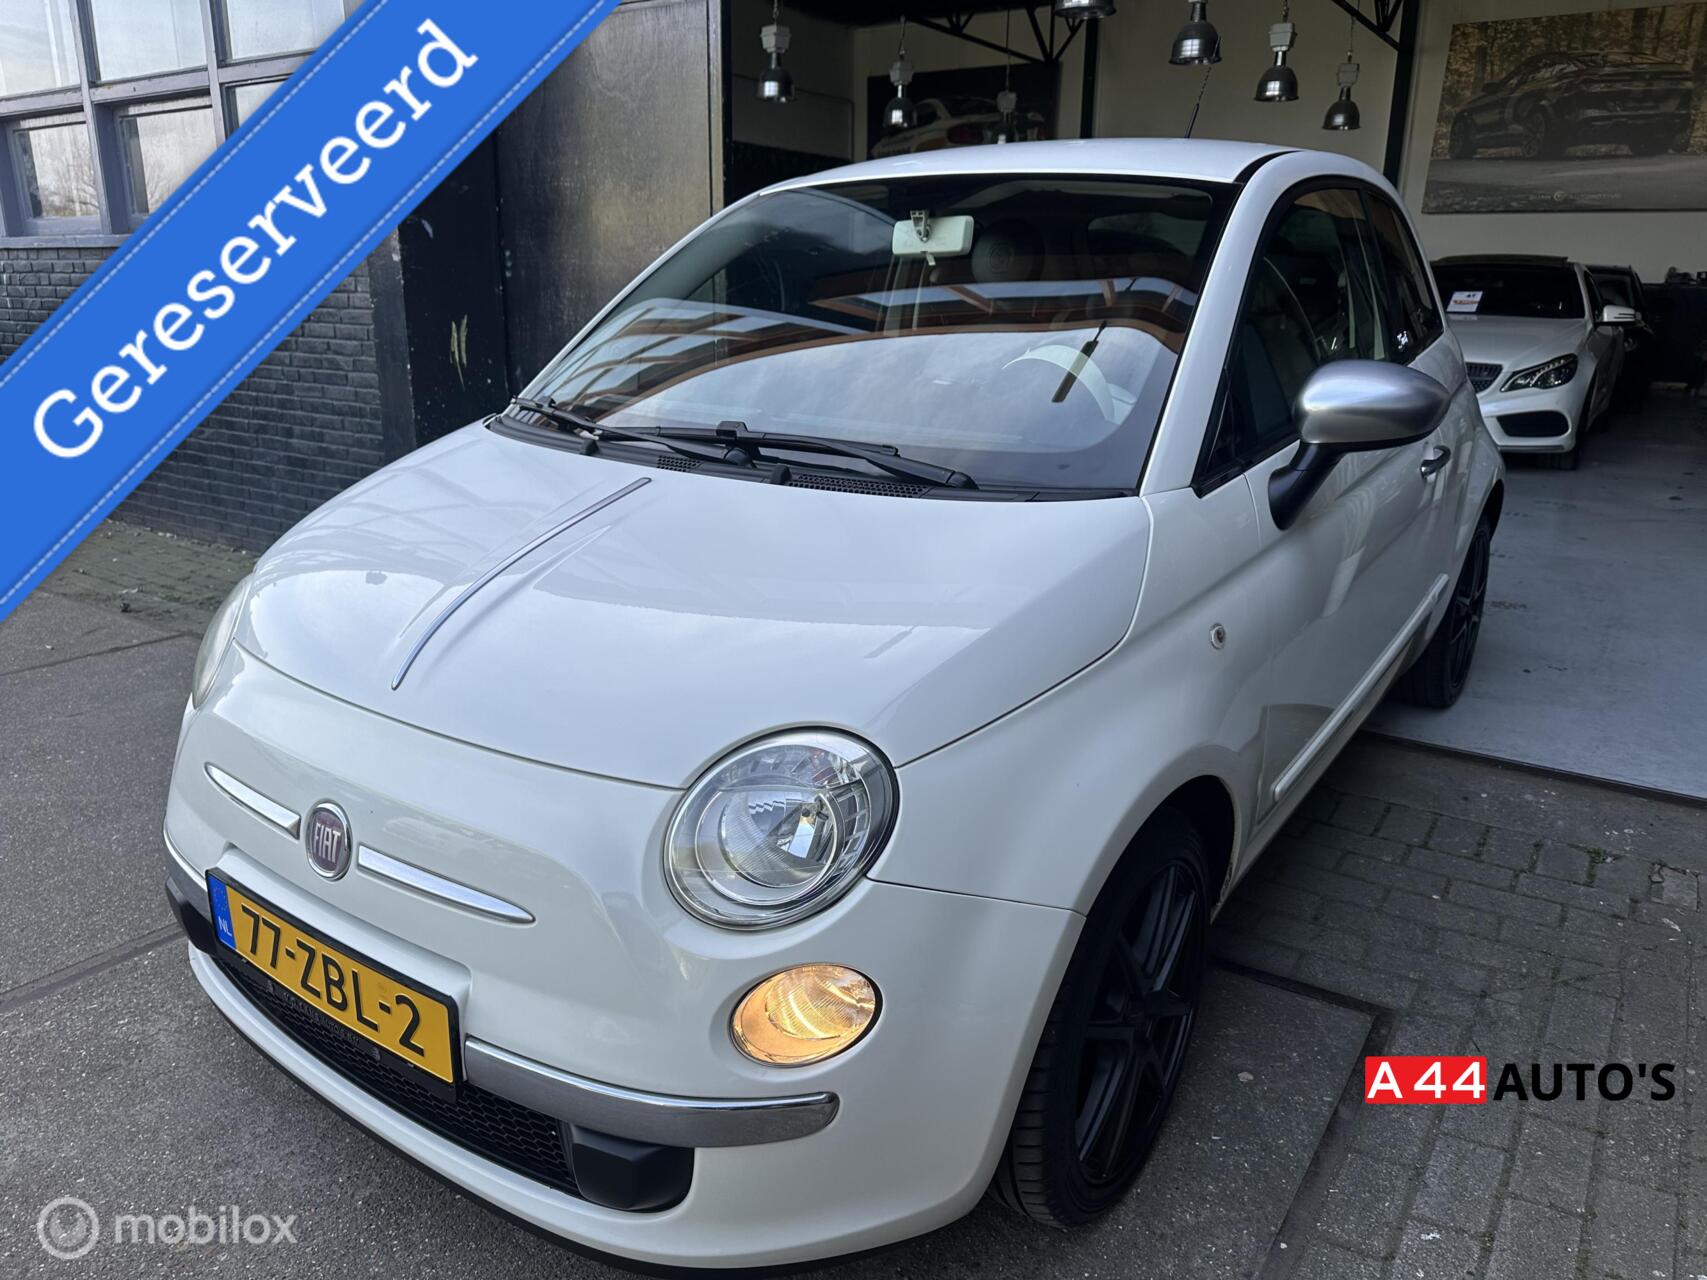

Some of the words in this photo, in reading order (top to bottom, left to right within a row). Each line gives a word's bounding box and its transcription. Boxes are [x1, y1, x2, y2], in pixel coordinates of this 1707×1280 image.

[313, 822, 341, 863] FIAT
[218, 915, 233, 937] NL
[241, 904, 424, 1057] 77-ZBL-2
